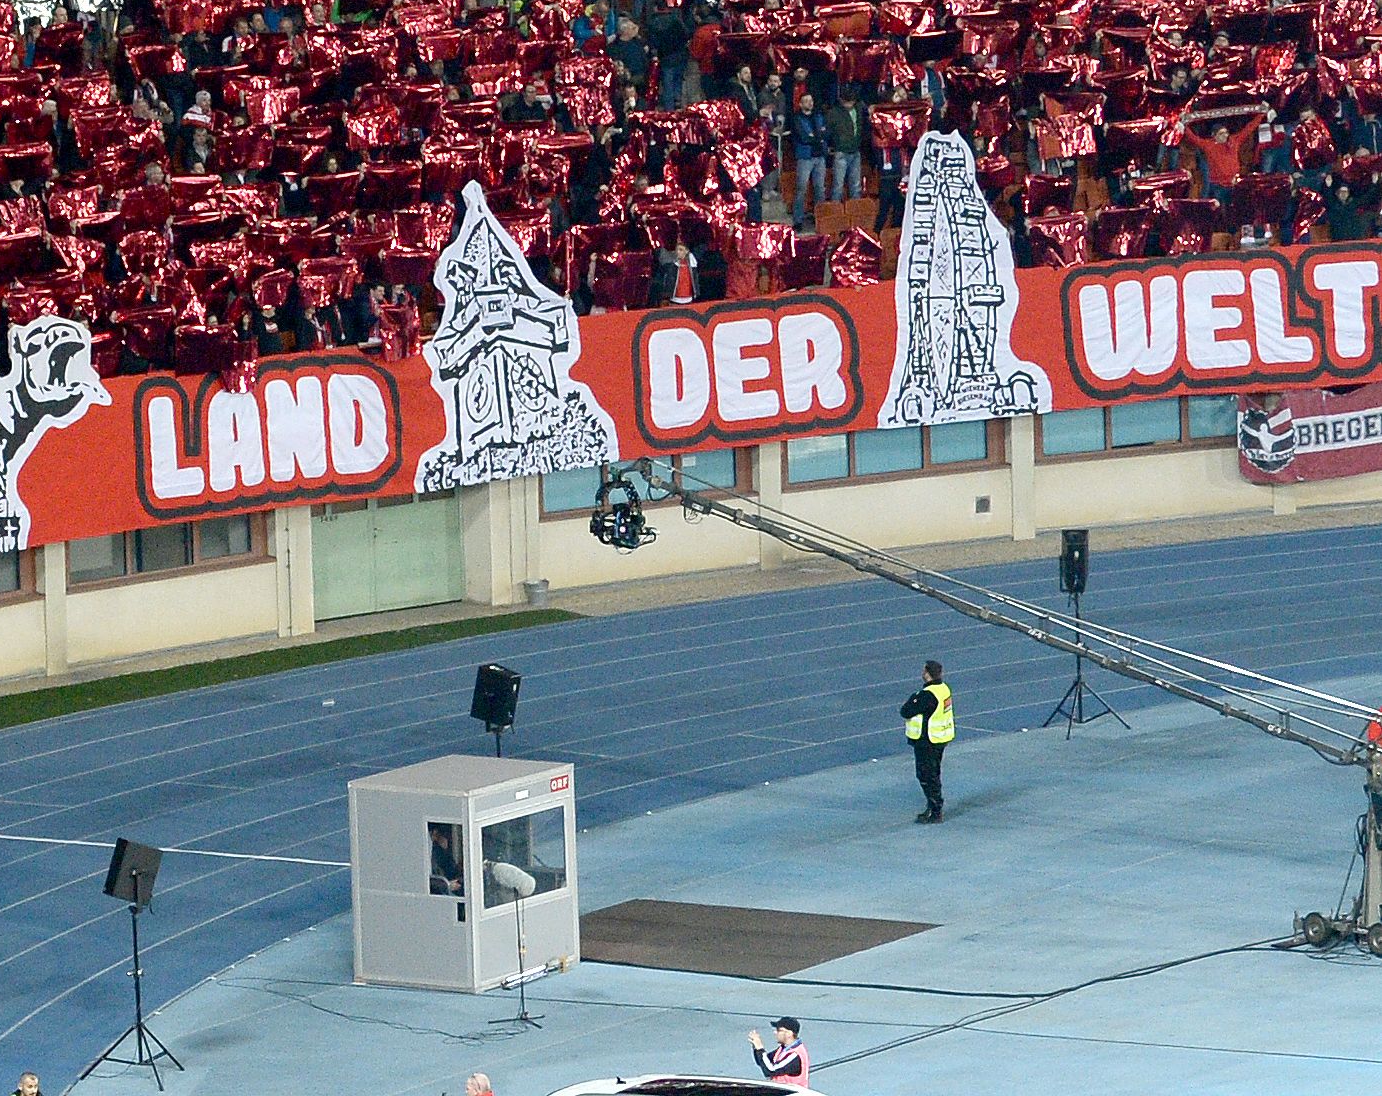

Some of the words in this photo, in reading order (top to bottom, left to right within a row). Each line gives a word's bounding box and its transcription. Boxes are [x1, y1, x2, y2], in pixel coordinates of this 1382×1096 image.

[147, 373, 390, 500] LAND
[647, 311, 847, 430] DER
[1078, 260, 1380, 381] WELT
[1296, 411, 1382, 447] BREGE
[551, 777, 569, 791] ORF
